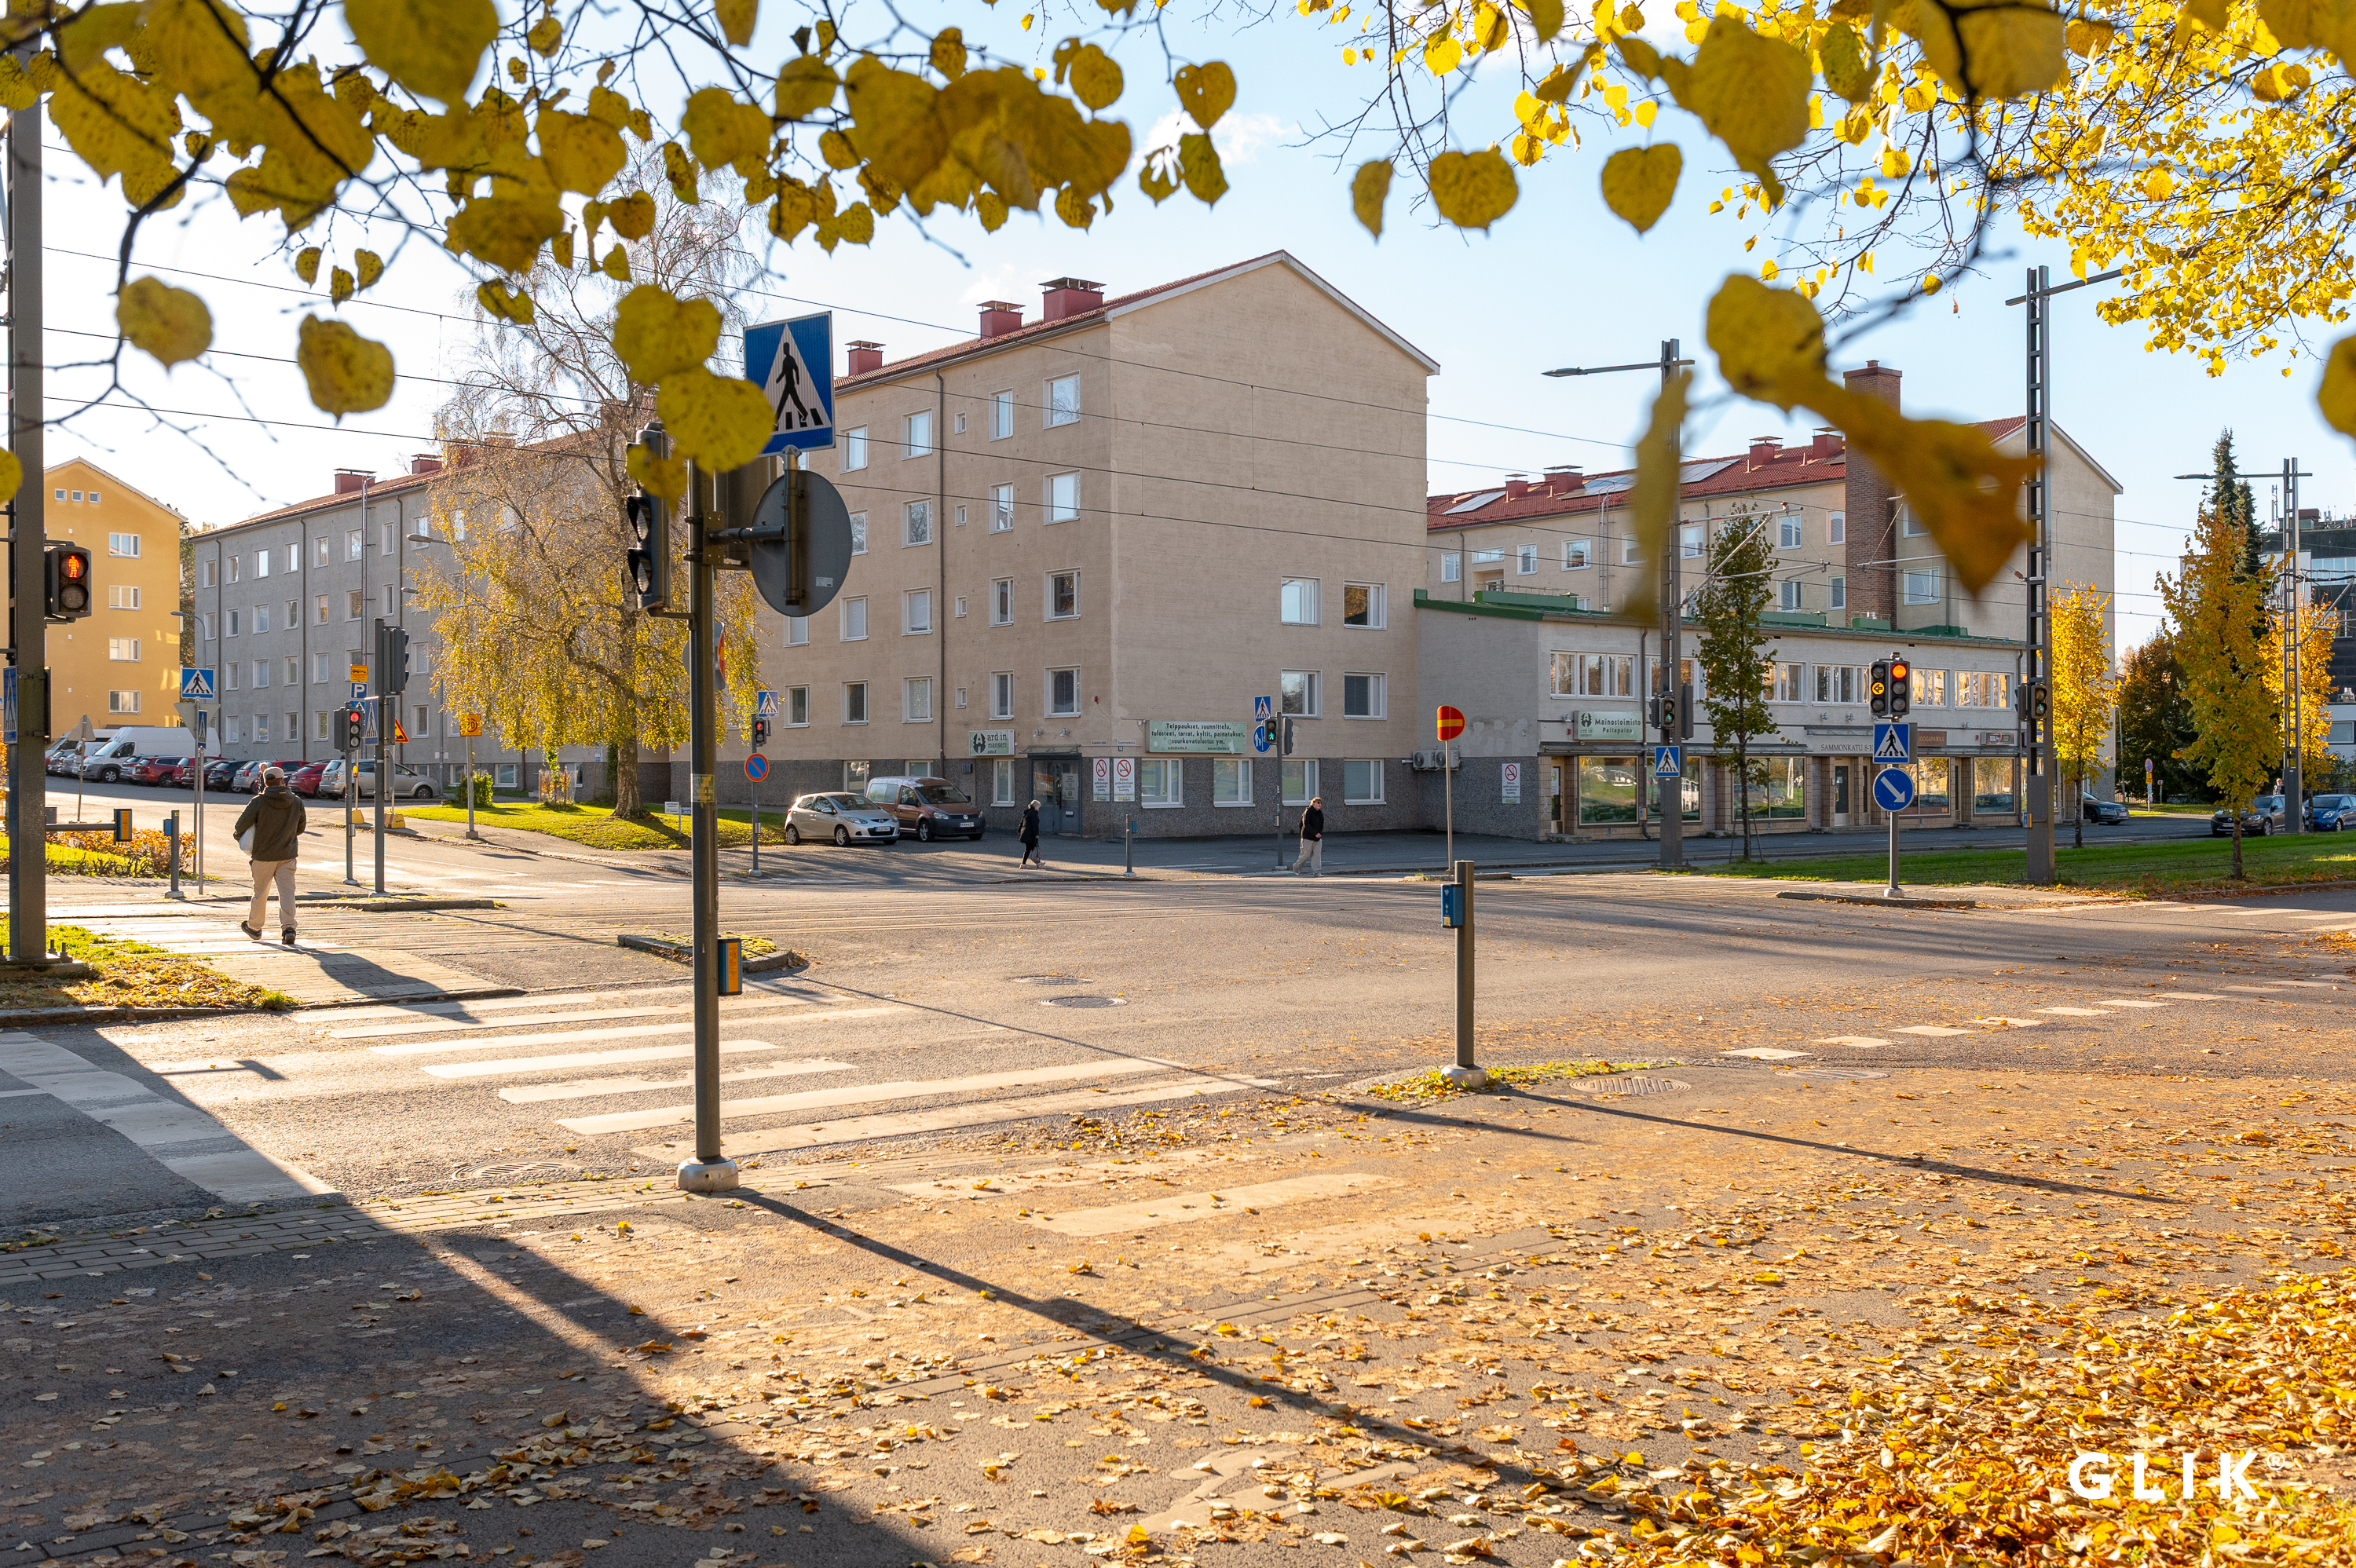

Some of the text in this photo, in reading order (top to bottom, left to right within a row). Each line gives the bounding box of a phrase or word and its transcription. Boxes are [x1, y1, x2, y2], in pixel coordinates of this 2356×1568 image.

[354, 684, 365, 698] P
[987, 732, 1008, 741] ard in
